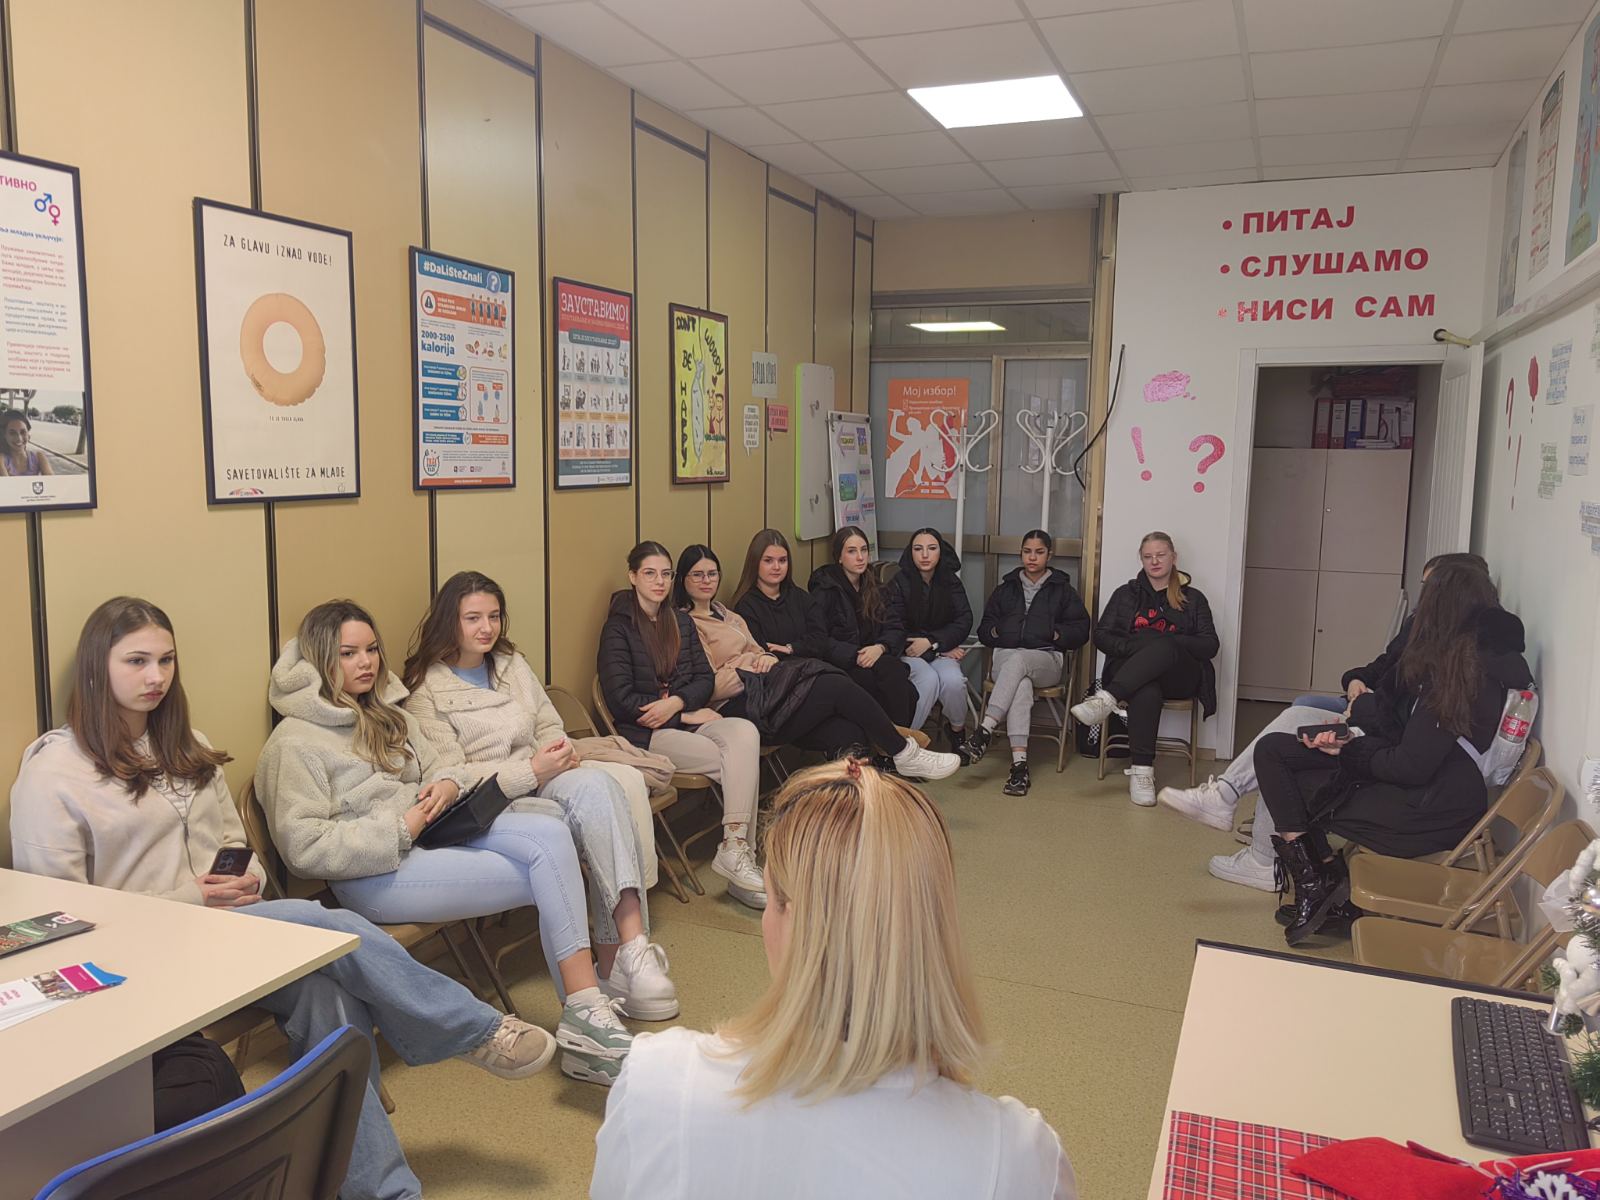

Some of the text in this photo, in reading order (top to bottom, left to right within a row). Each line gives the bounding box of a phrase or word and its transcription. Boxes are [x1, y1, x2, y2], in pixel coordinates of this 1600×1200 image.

[1242, 205, 1355, 234] ПИТАЈ
[223, 234, 332, 266] ZA GLAVU IZNAD VODE!
[1240, 248, 1429, 277] СЛУШАМО
[423, 260, 483, 284] #DaLiSteZnali
[561, 292, 629, 331] ЗАУСТАВИМО!
[1237, 294, 1436, 323] НИСИ САМ
[421, 330, 455, 342] 2000-2500
[421, 341, 455, 356] kalorija
[682, 350, 693, 371] BE
[704, 327, 724, 376] WORRY
[903, 385, 956, 399] Мој избор!
[680, 381, 688, 468] HAPPY
[226, 466, 345, 481] SAVETOVALIŠTE ZA MLADE
